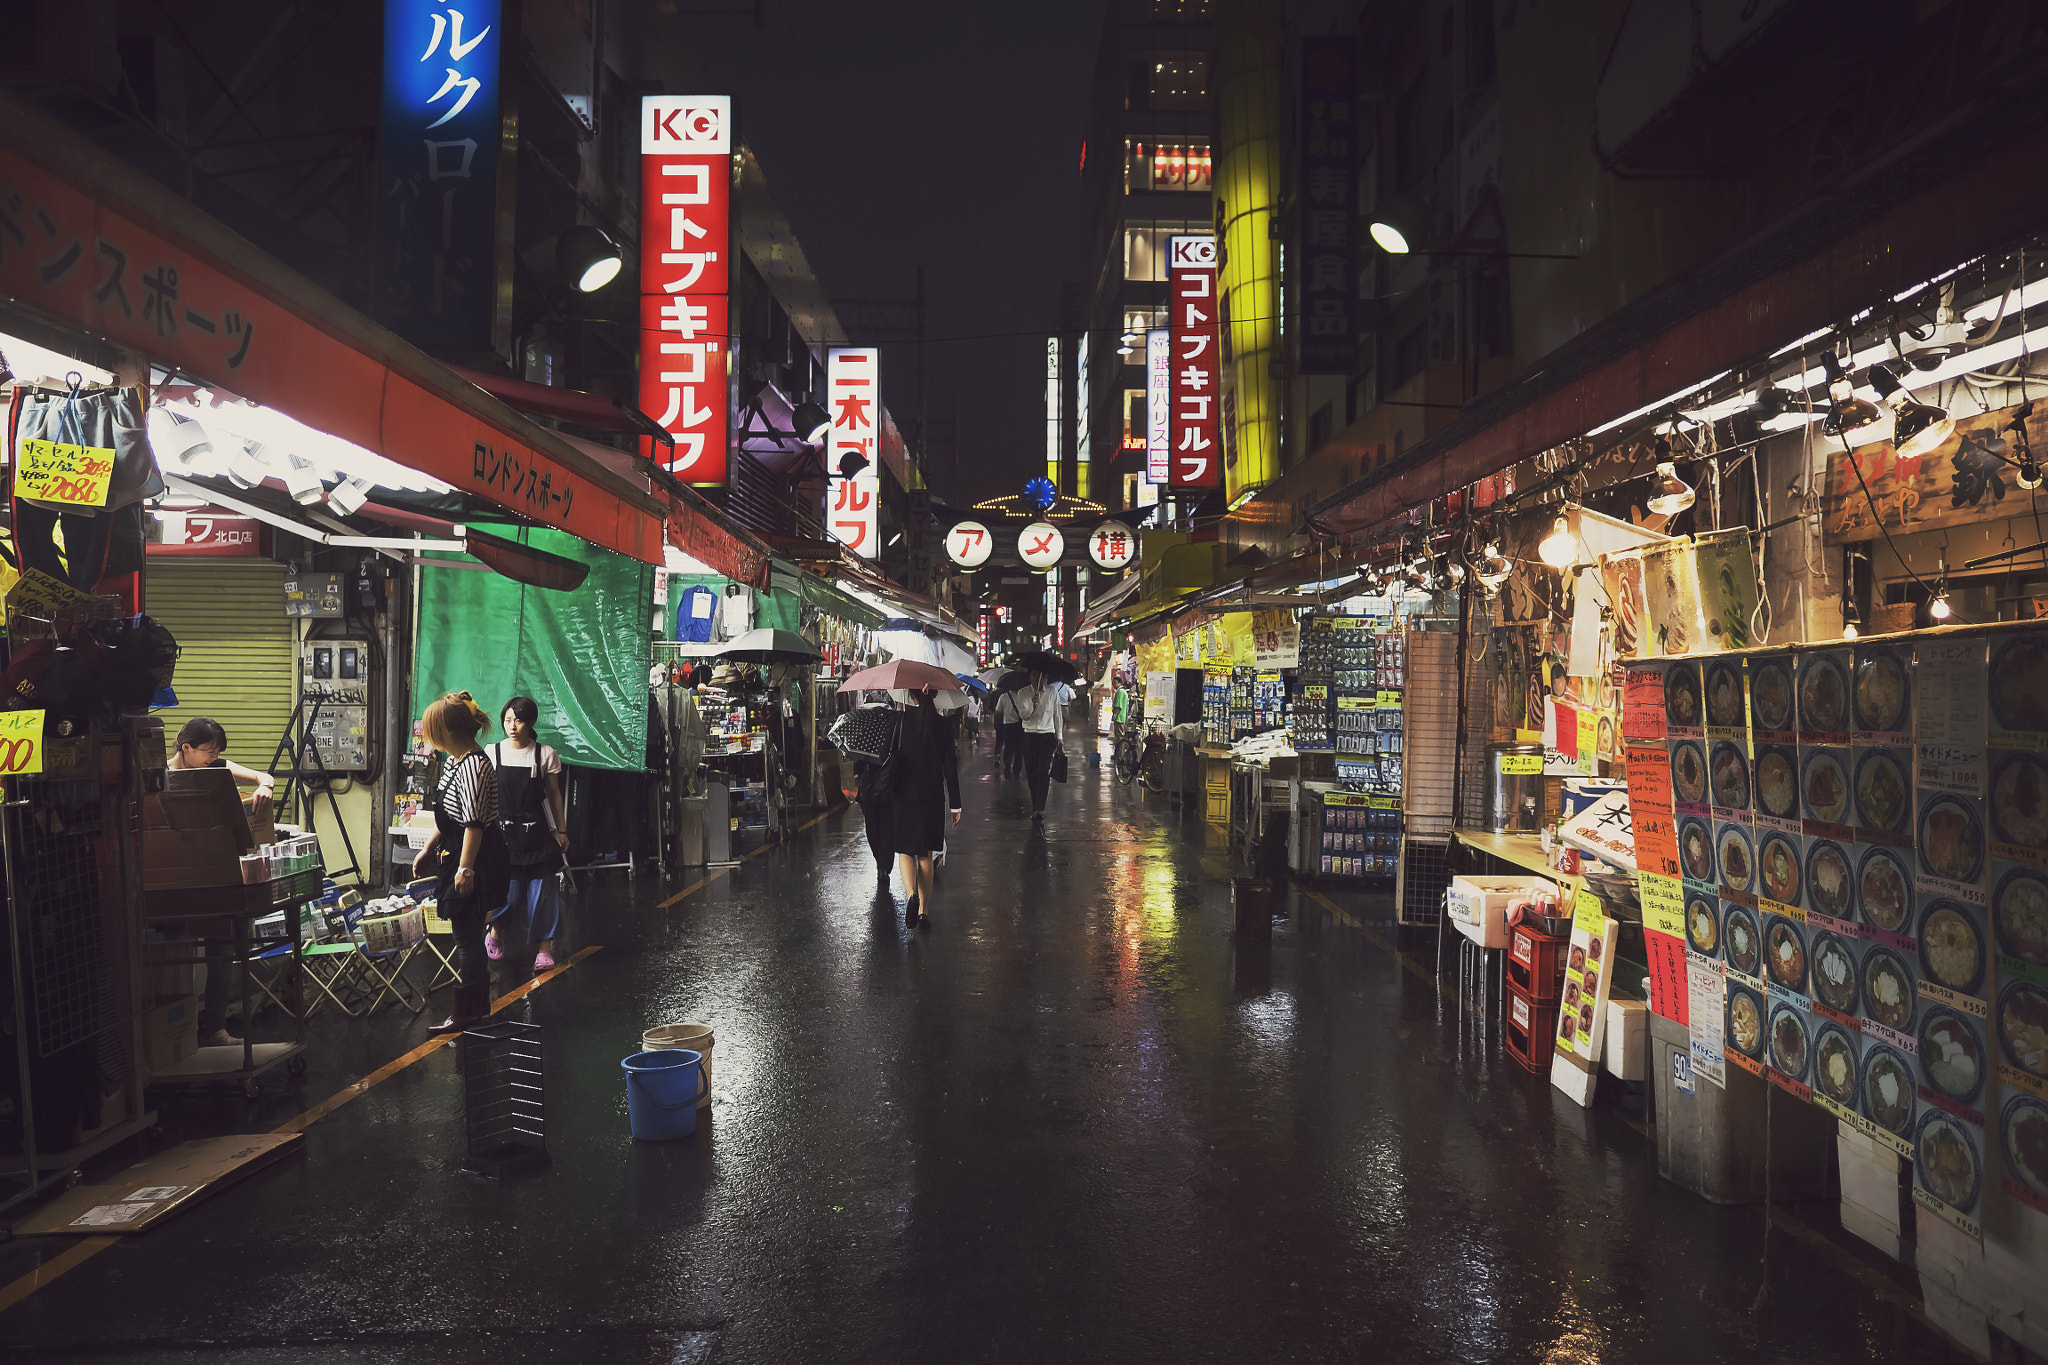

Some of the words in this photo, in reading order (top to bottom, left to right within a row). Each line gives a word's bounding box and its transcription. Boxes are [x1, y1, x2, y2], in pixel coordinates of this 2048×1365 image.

[653, 108, 719, 141] KG
[420, 0, 491, 319] ルクロード
[1174, 241, 1215, 263] KG
[1309, 165, 1349, 336] 寿屋食品
[656, 164, 719, 474] コトブキゴルフ
[1178, 274, 1212, 482] コトブキゴルフ
[472, 442, 575, 519] ロンドンスポーツ
[215, 530, 253, 543] 北口店
[1920, 746, 1979, 762] サイドメニュー
[1785, 823, 1800, 832] ¥550
[1660, 855, 1679, 876] ¥100
[1962, 888, 1985, 903] ¥550
[1790, 910, 1804, 921] ¥650
[1840, 923, 1857, 936] ¥600
[1896, 938, 1915, 952] ¥500
[1708, 962, 1721, 974] ¥650
[1694, 972, 1717, 989] トッピング
[1795, 997, 1809, 1010] ¥550
[1962, 1000, 1986, 1016] ¥550
[1861, 1018, 1896, 1041] 白子・マグロ丼
[1897, 1037, 1917, 1054] ¥650
[1691, 1040, 1723, 1062] サイドメニュー
[1859, 1116, 1876, 1134] 二色丼
[1895, 1140, 1914, 1158] ¥550
[1924, 1192, 1944, 1212] マグロ丼
[1955, 1215, 1978, 1236] ¥900
